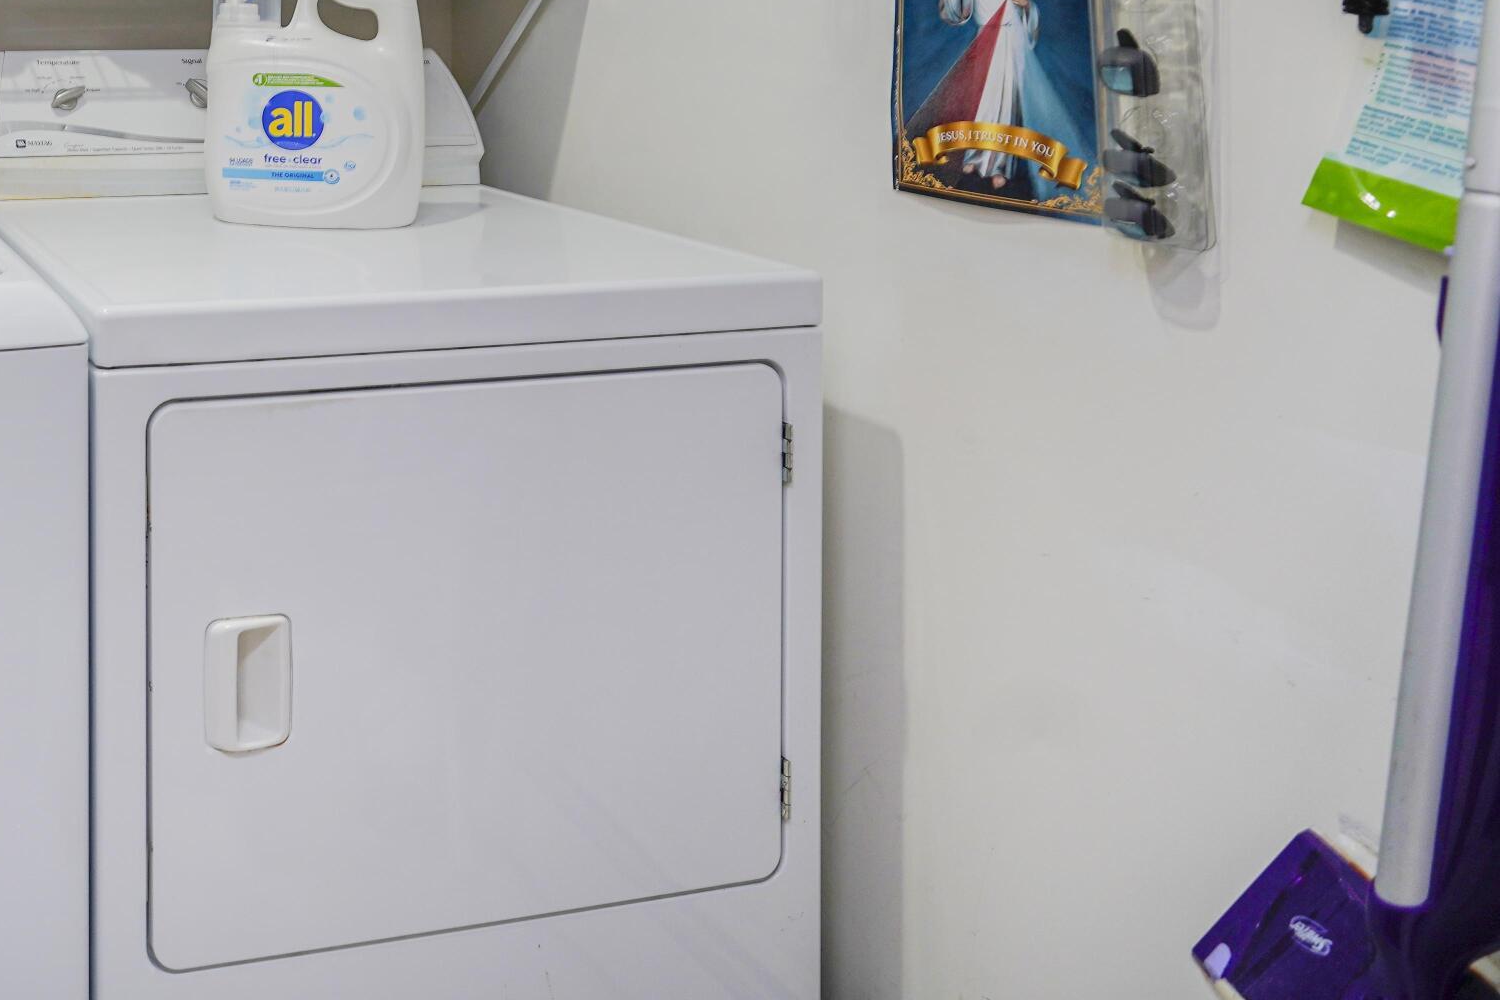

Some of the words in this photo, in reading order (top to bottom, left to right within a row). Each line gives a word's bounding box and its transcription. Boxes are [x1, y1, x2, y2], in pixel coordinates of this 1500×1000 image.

[267, 100, 314, 139] all
[263, 153, 287, 164] free
[292, 153, 323, 165] clear
[973, 130, 1012, 147] TRUST
[1013, 136, 1028, 150] IN
[1031, 140, 1055, 159] YOU
